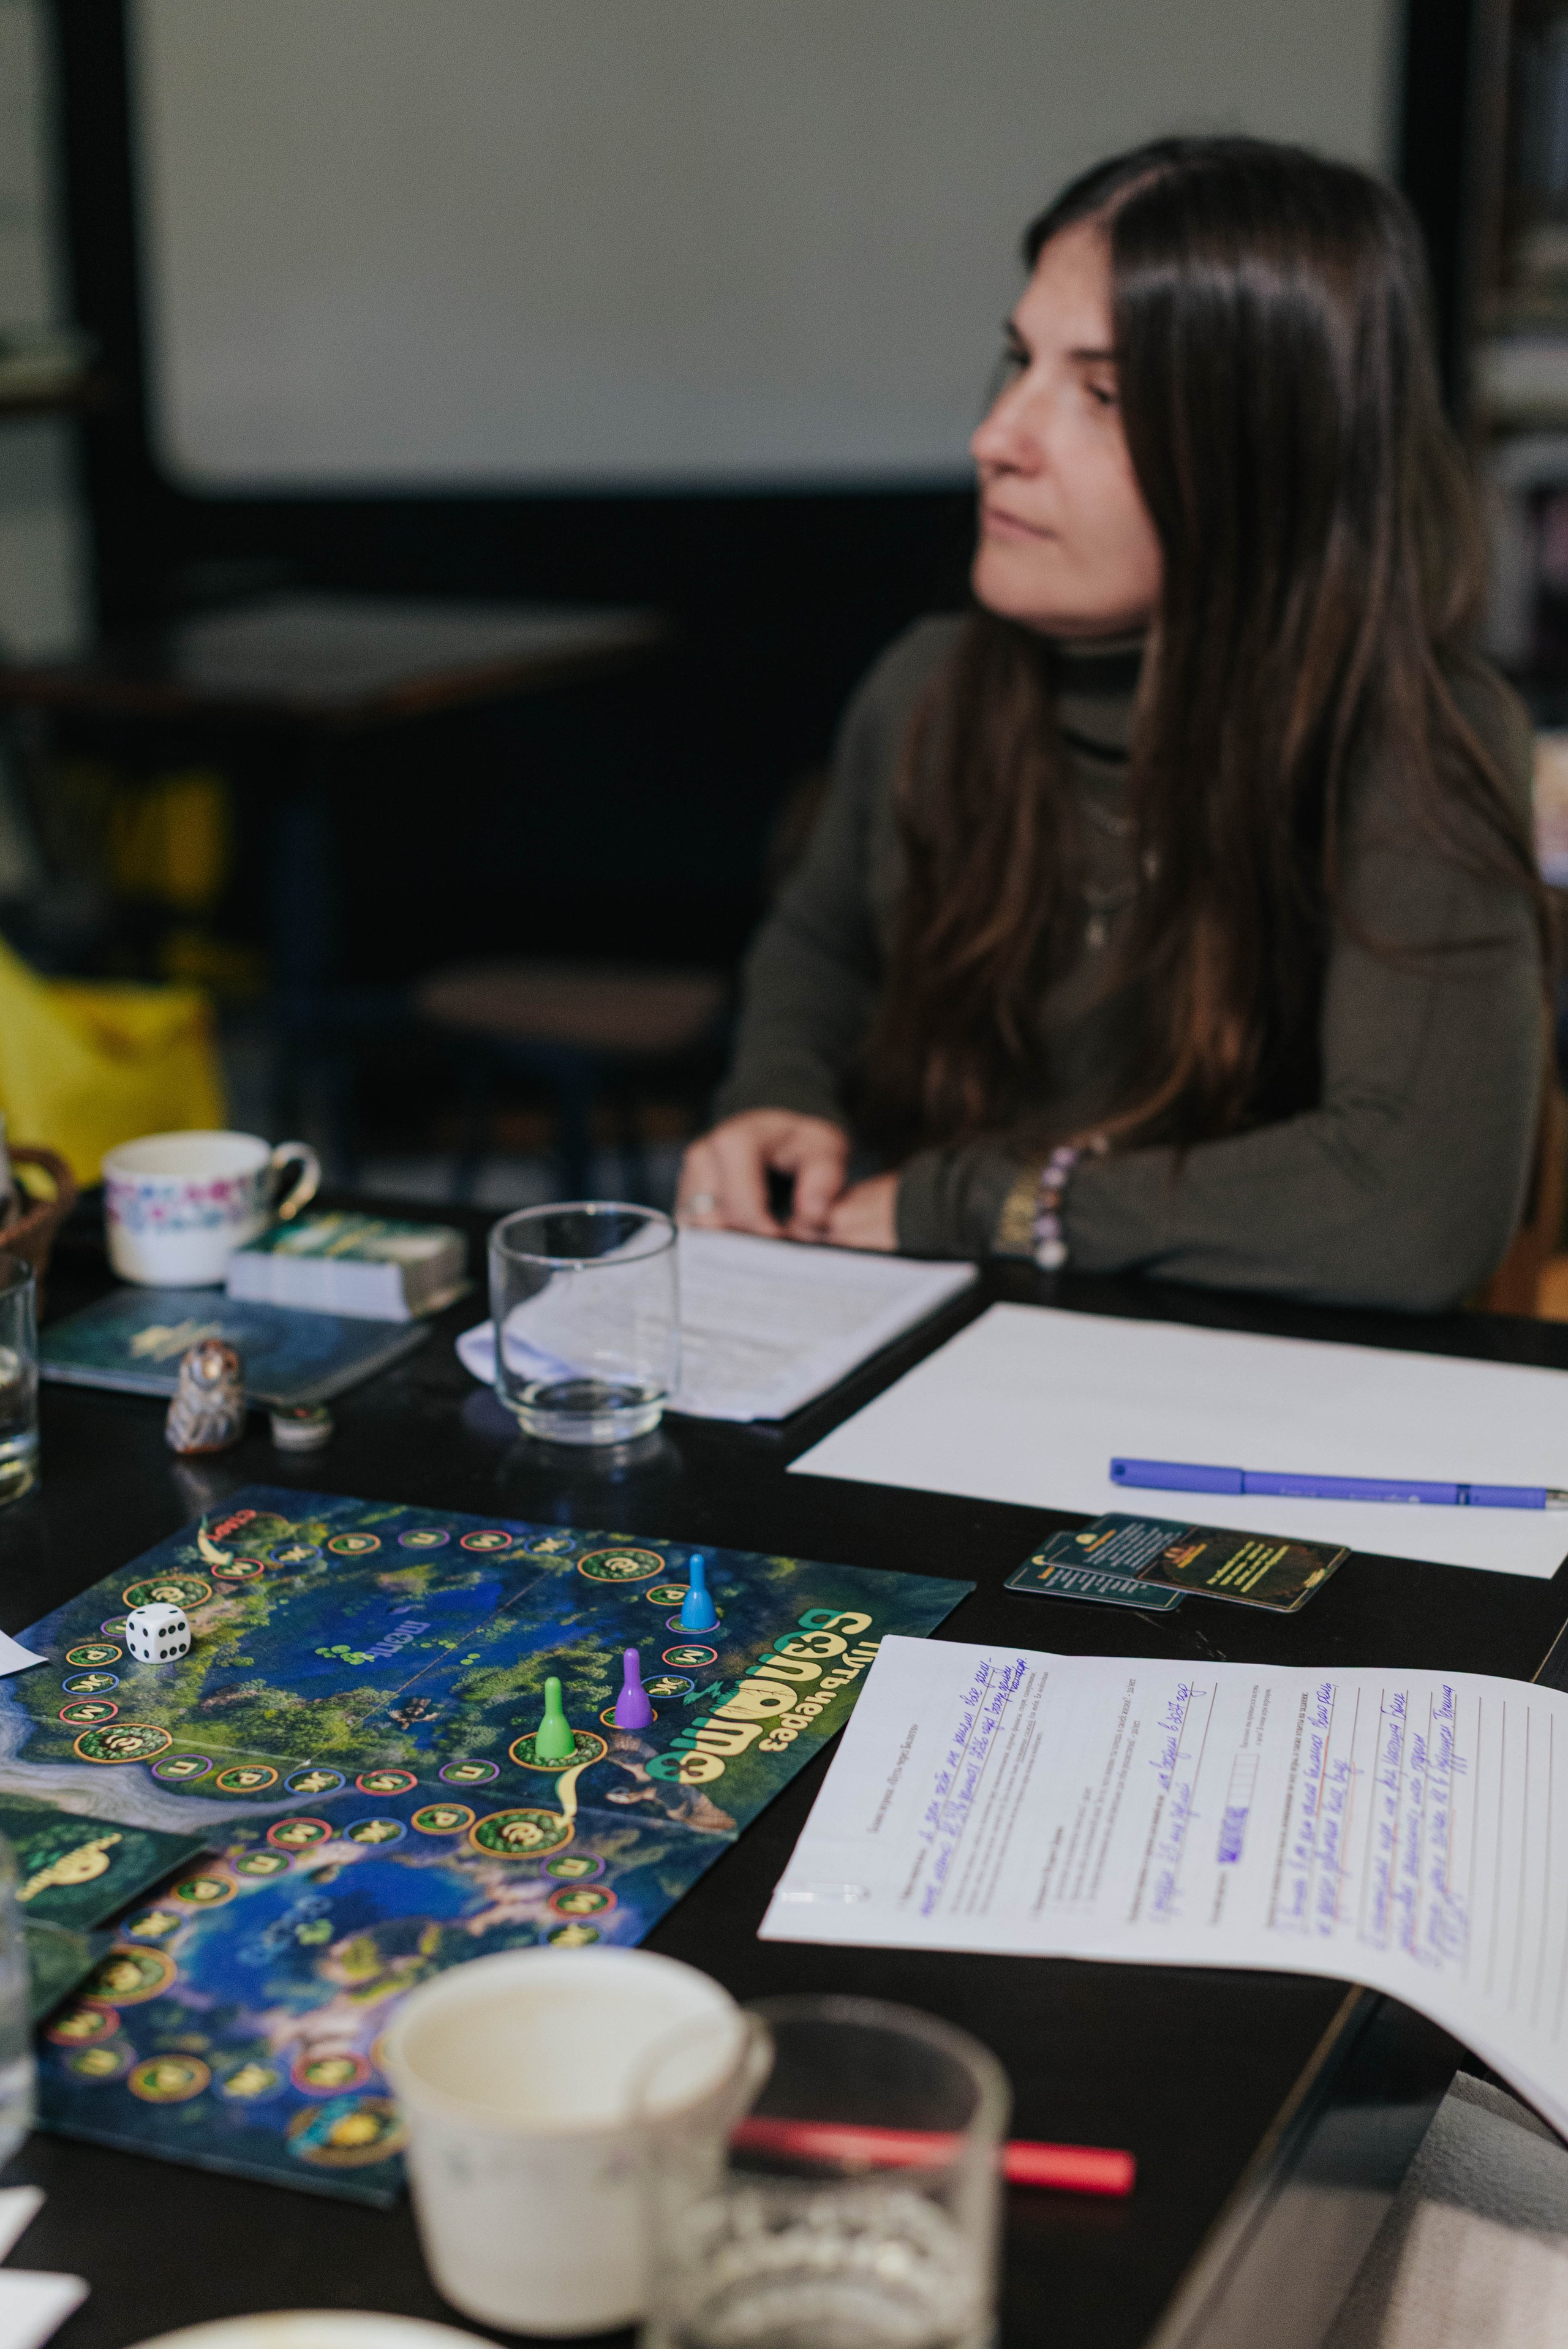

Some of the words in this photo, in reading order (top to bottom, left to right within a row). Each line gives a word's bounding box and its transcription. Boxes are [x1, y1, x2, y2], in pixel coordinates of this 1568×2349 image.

[676, 1650, 704, 1662] М
[831, 1641, 881, 1695] Путь
[650, 1678, 683, 1694] Ж
[758, 1689, 838, 1753] через
